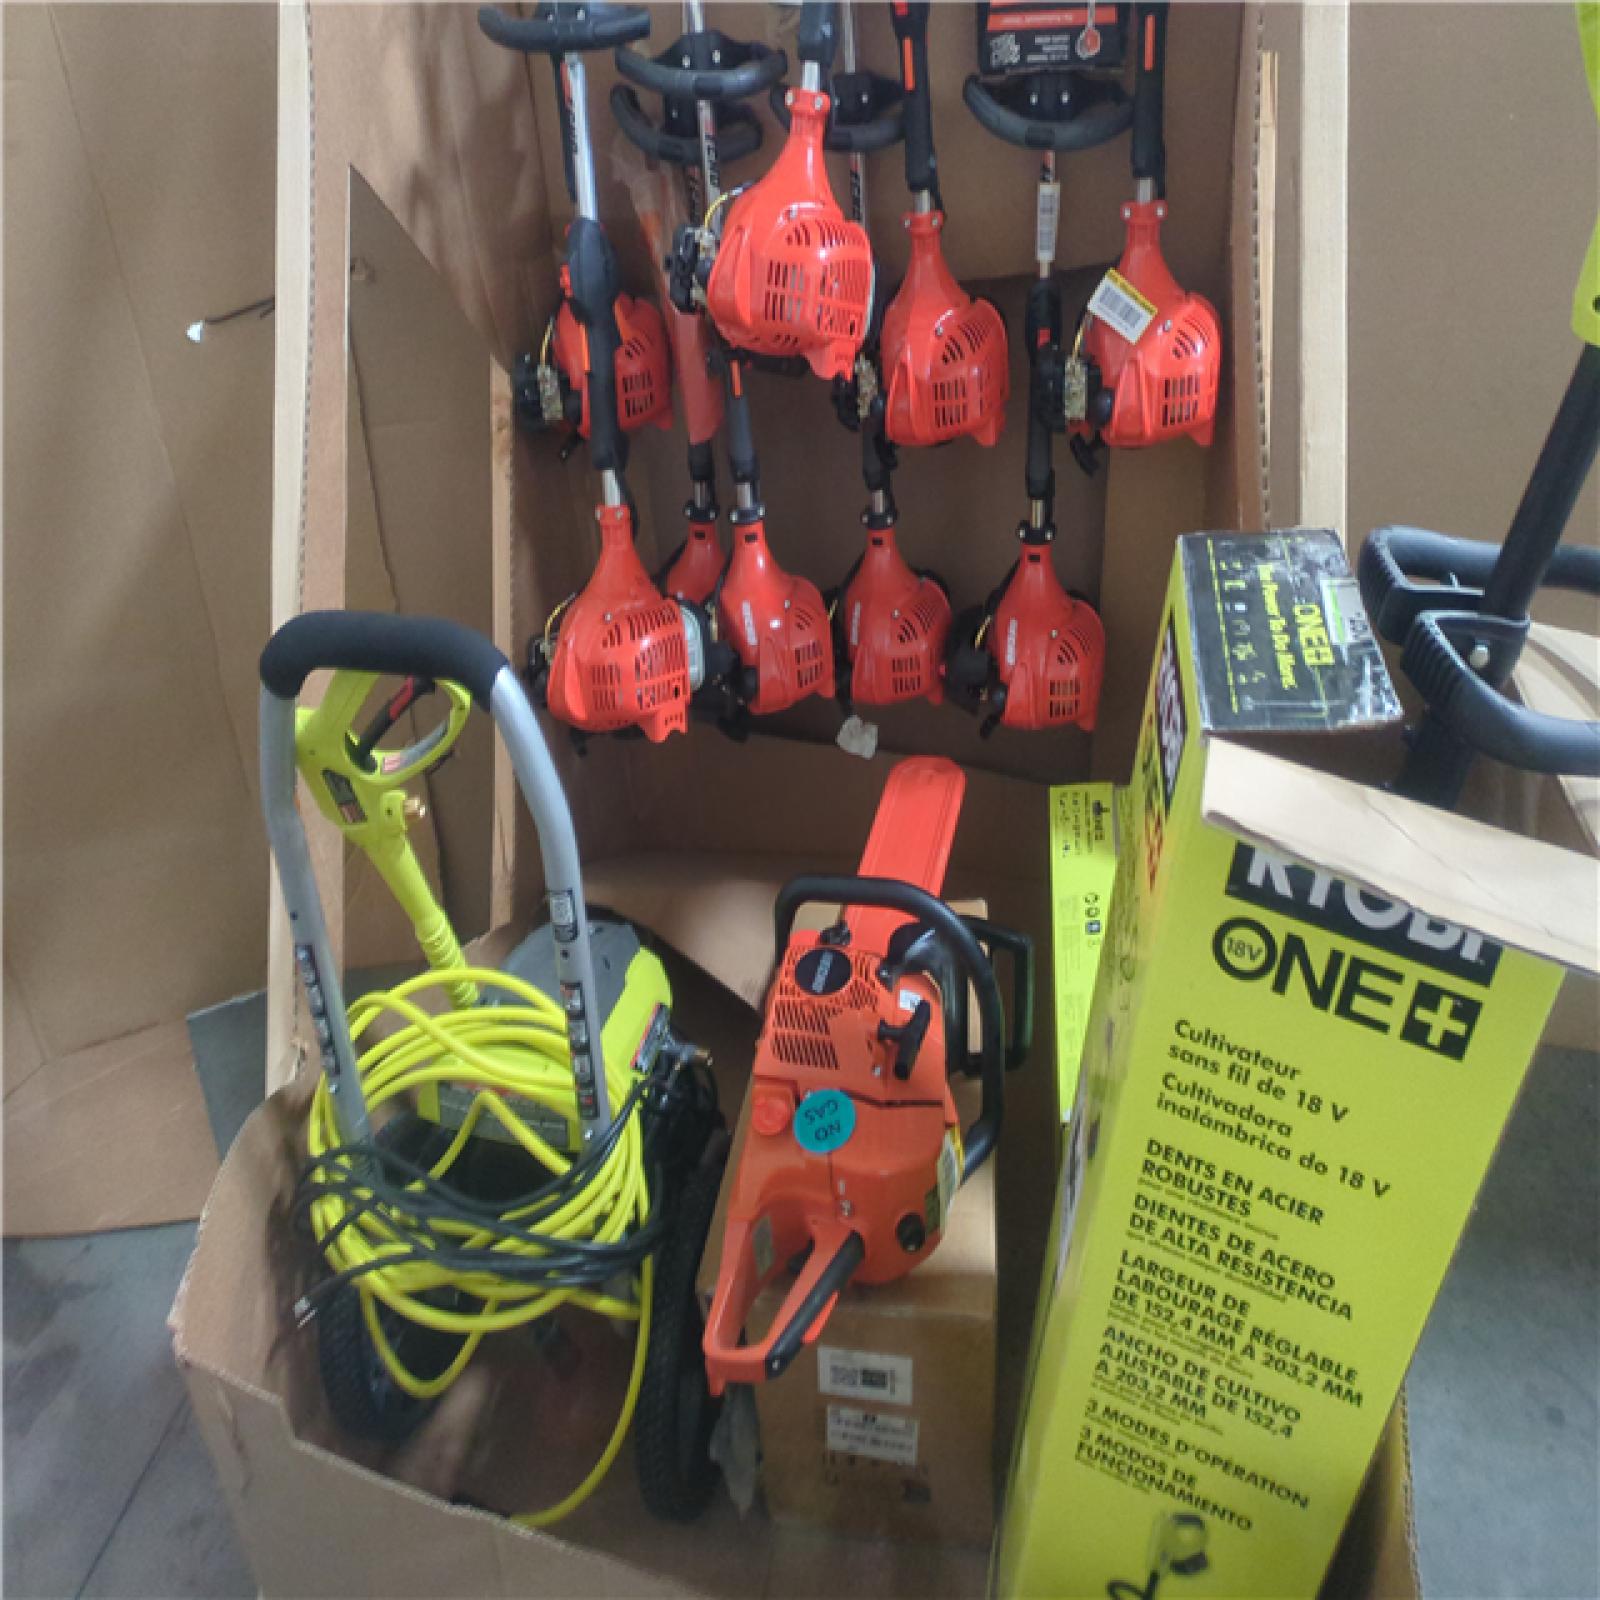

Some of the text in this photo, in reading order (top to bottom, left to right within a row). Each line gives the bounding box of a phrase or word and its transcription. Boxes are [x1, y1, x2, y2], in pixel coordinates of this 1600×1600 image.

[1226, 936, 1263, 962] 18V
[1175, 1019, 1301, 1080] Cultivateur
[804, 1098, 839, 1126] GAS
[1162, 1072, 1293, 1138] Cultivadora
[1168, 1045, 1349, 1123] sans fil de 18 V
[814, 1119, 841, 1141] NO
[1142, 1158, 1252, 1217] ROBUSTES
[1145, 1137, 1217, 1180] DENTS
[1221, 1170, 1253, 1197] EN
[1257, 1185, 1325, 1225] ACIER
[1340, 1165, 1365, 1190] 18
[1373, 1178, 1390, 1198] V
[1130, 1212, 1157, 1237] DE
[1160, 1227, 1210, 1260] ALTA
[1214, 1250, 1352, 1320] RESISTENCIA
[1133, 1192, 1220, 1242] DIENTES
[1225, 1232, 1255, 1258] DE
[1260, 1248, 1335, 1290] ACERO
[1115, 1267, 1246, 1335] LABOURAGE
[1120, 1250, 1217, 1302] LARGEUR
[1222, 1292, 1250, 1318] DE
[1100, 1342, 1207, 1400] AJUSTABLE
[1212, 1391, 1238, 1415] DE
[1103, 1325, 1178, 1368] ANCHO
[1183, 1360, 1210, 1383] DE
[1215, 1375, 1300, 1423] CULTIVO
[1112, 1285, 1139, 1309] DE
[1197, 1323, 1235, 1352] MM
[1322, 1378, 1363, 1408] MM
[1085, 1398, 1098, 1420] 3
[1101, 1405, 1170, 1447] MODES
[1095, 1359, 1108, 1375] A
[1170, 1392, 1207, 1420] MM
[1075, 1440, 1252, 1530] FUNCIONAMIENTO
[1095, 1432, 1167, 1476] MODOS
[1172, 1467, 1197, 1490] DE
